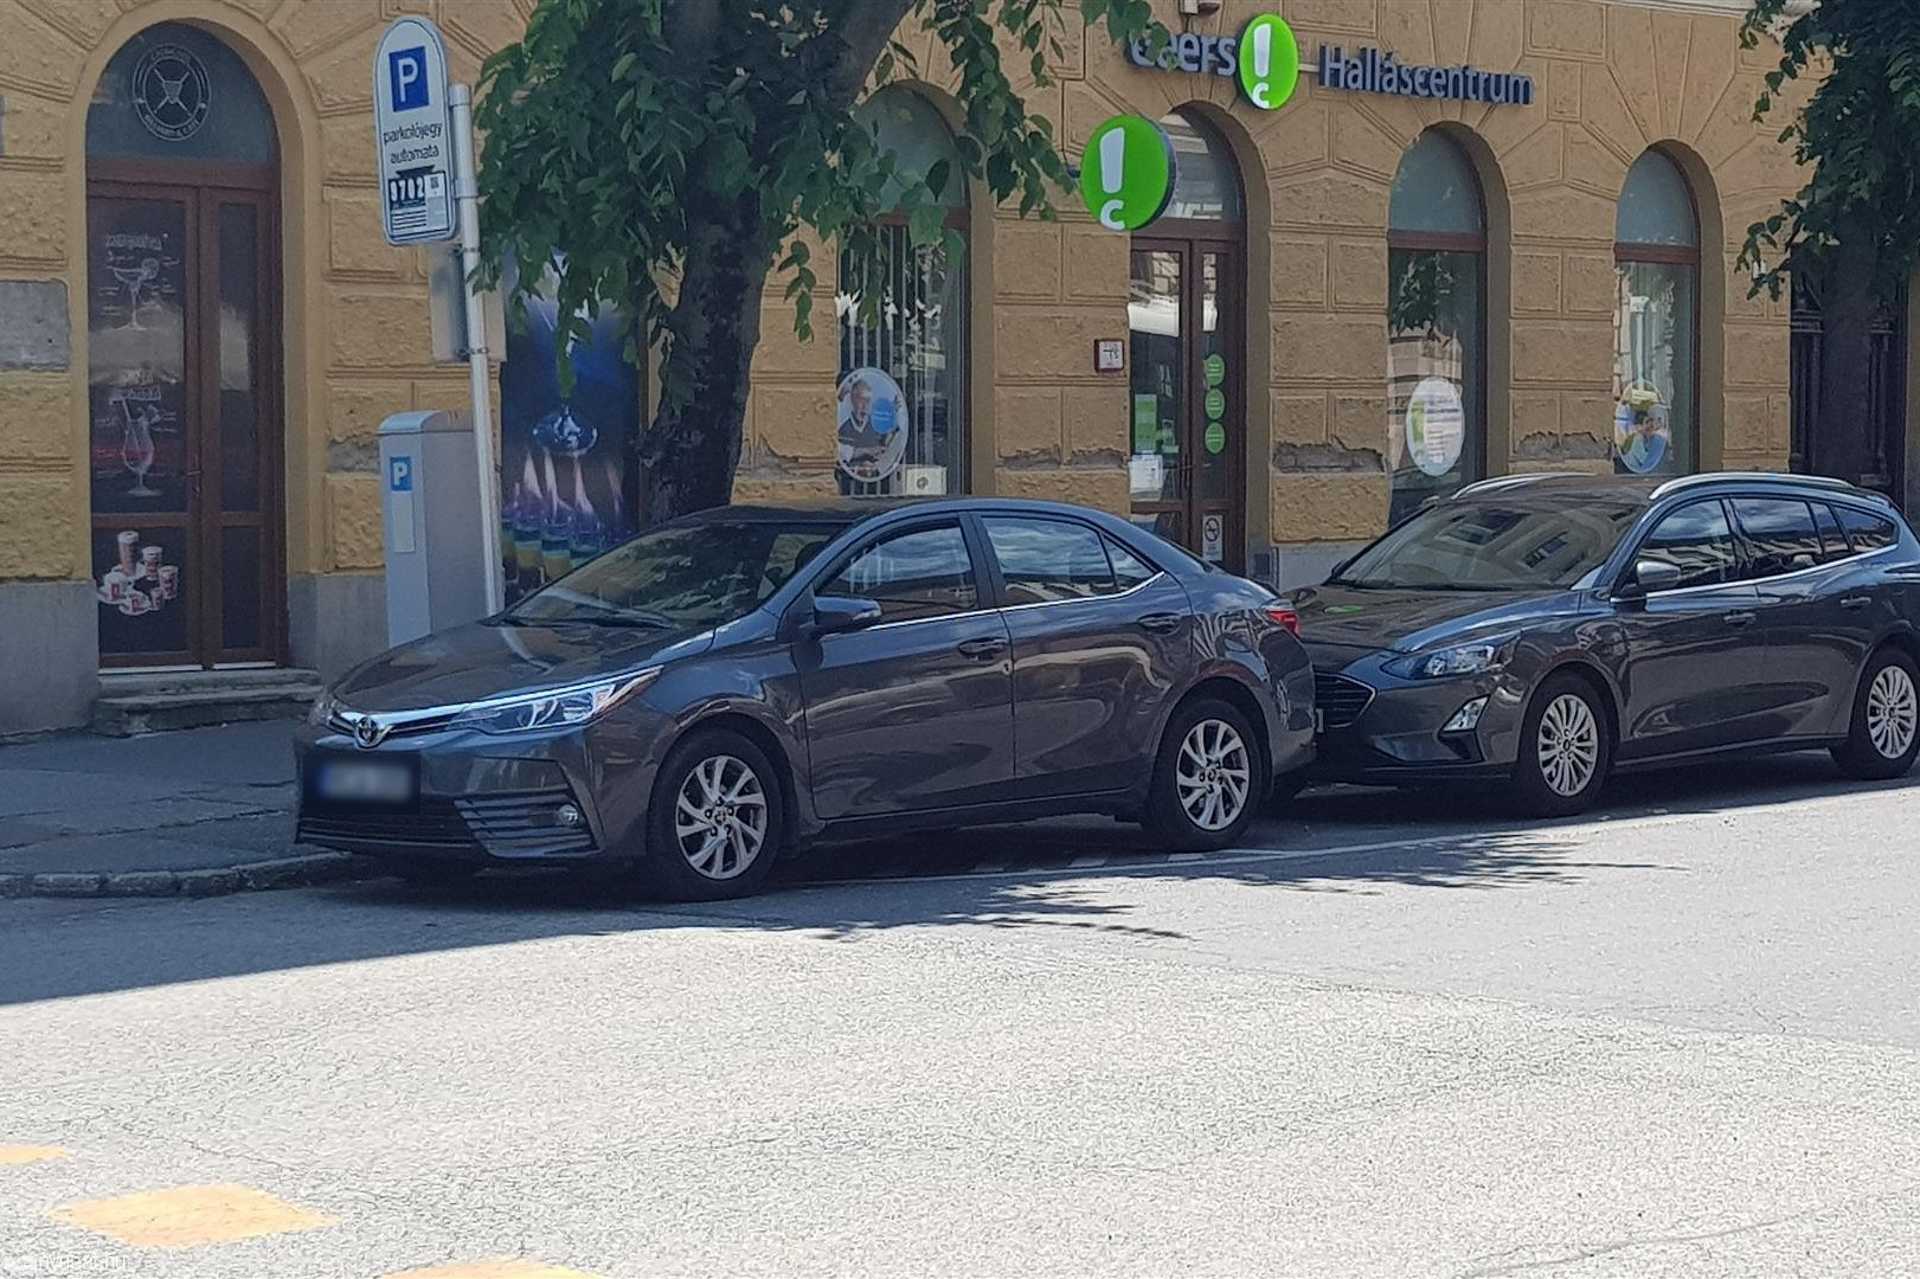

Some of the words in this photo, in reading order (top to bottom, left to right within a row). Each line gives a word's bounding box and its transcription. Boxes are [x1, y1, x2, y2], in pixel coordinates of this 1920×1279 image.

[398, 56, 419, 103] P
[1321, 44, 1533, 107] Halláscentrum
[383, 122, 442, 145] parkolójegy
[390, 144, 439, 164] automata
[393, 462, 408, 486] P
